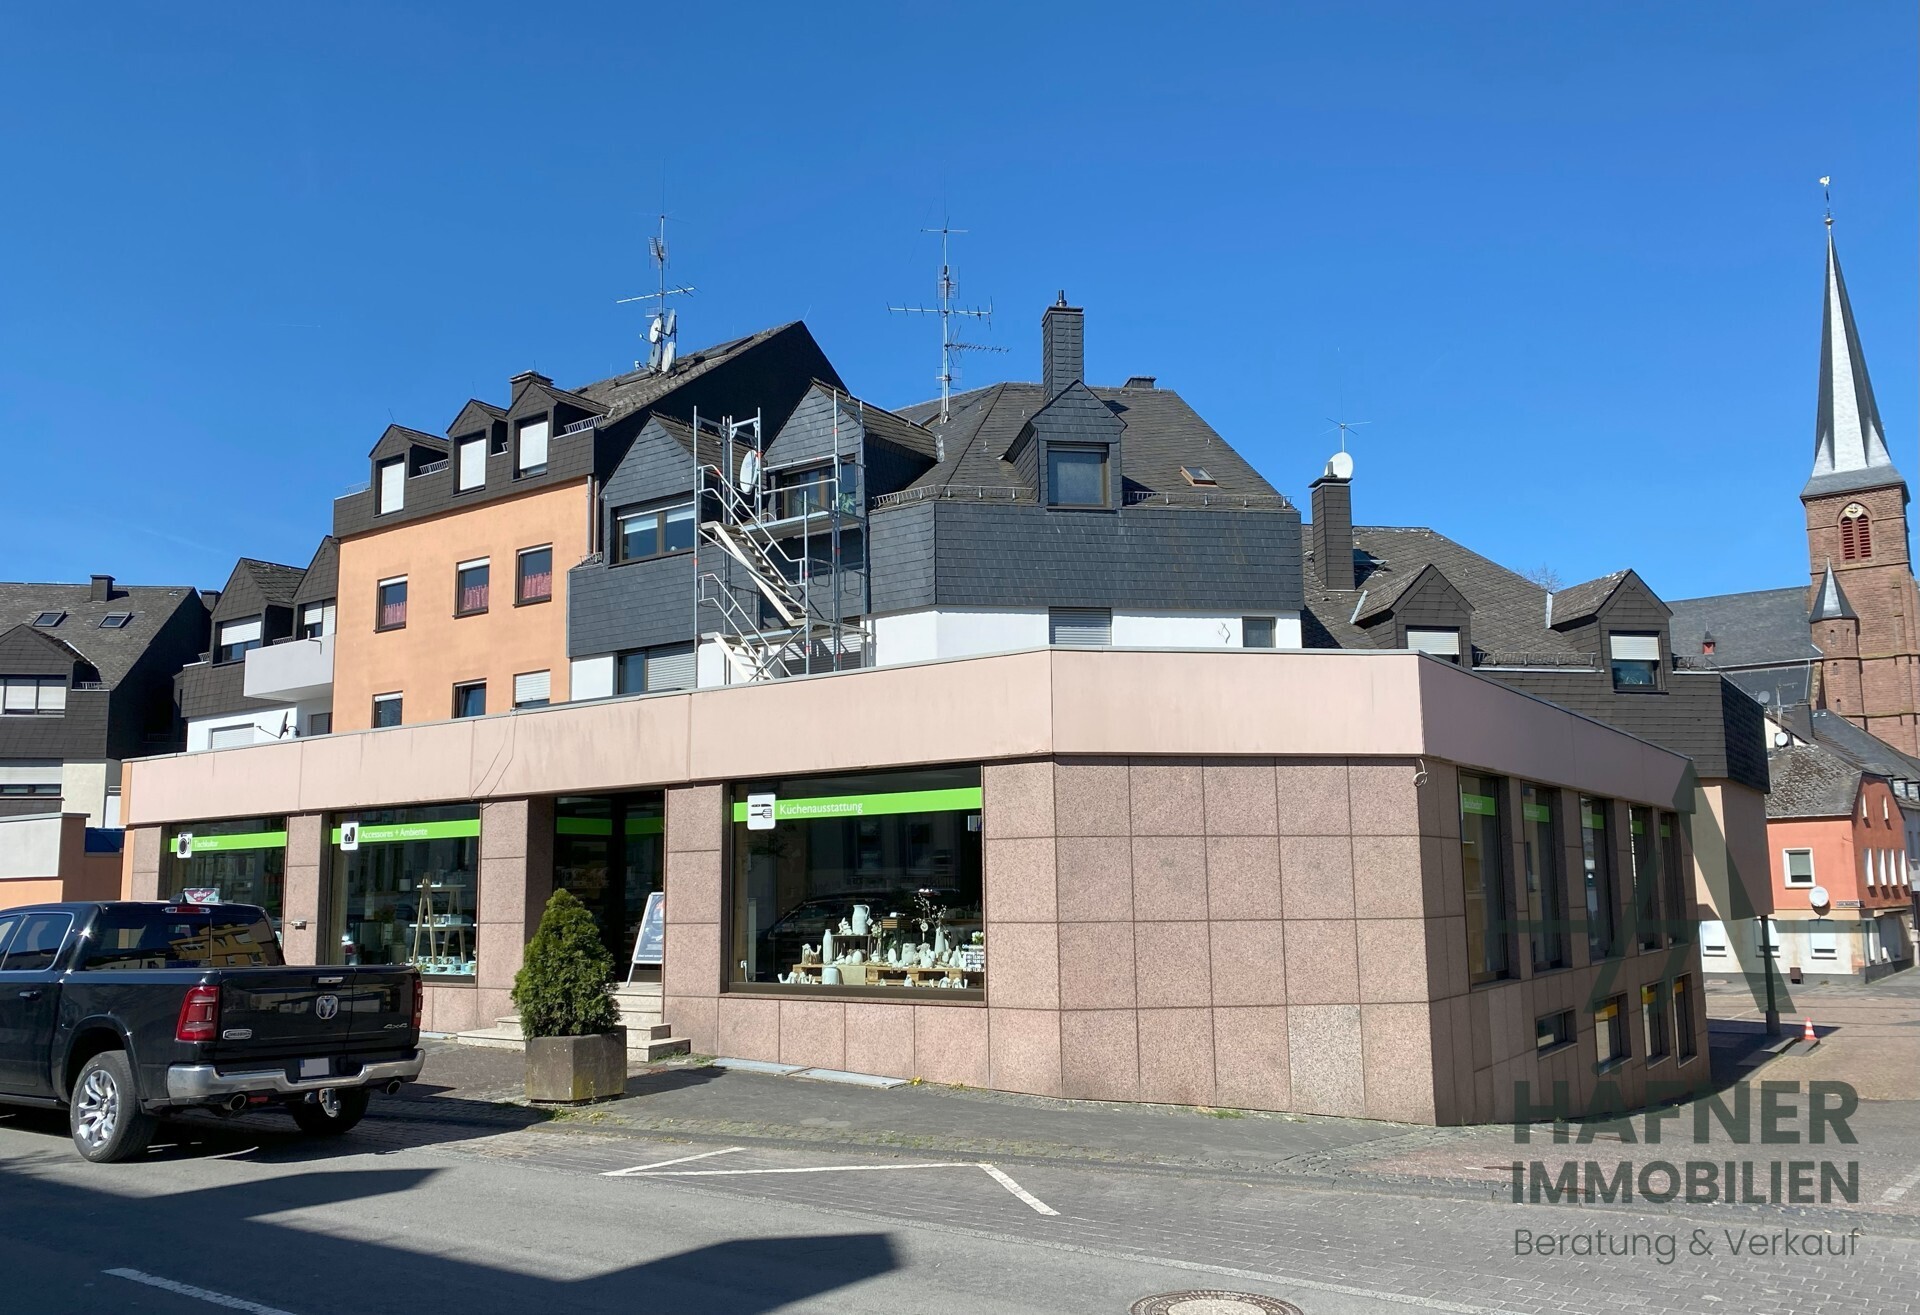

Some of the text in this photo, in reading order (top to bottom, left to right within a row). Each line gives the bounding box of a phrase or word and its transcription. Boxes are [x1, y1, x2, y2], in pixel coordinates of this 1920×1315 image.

[780, 803, 863, 815] Küchenausstattung
[361, 830, 393, 839] Accessoires
[400, 827, 428, 837] Ambiente
